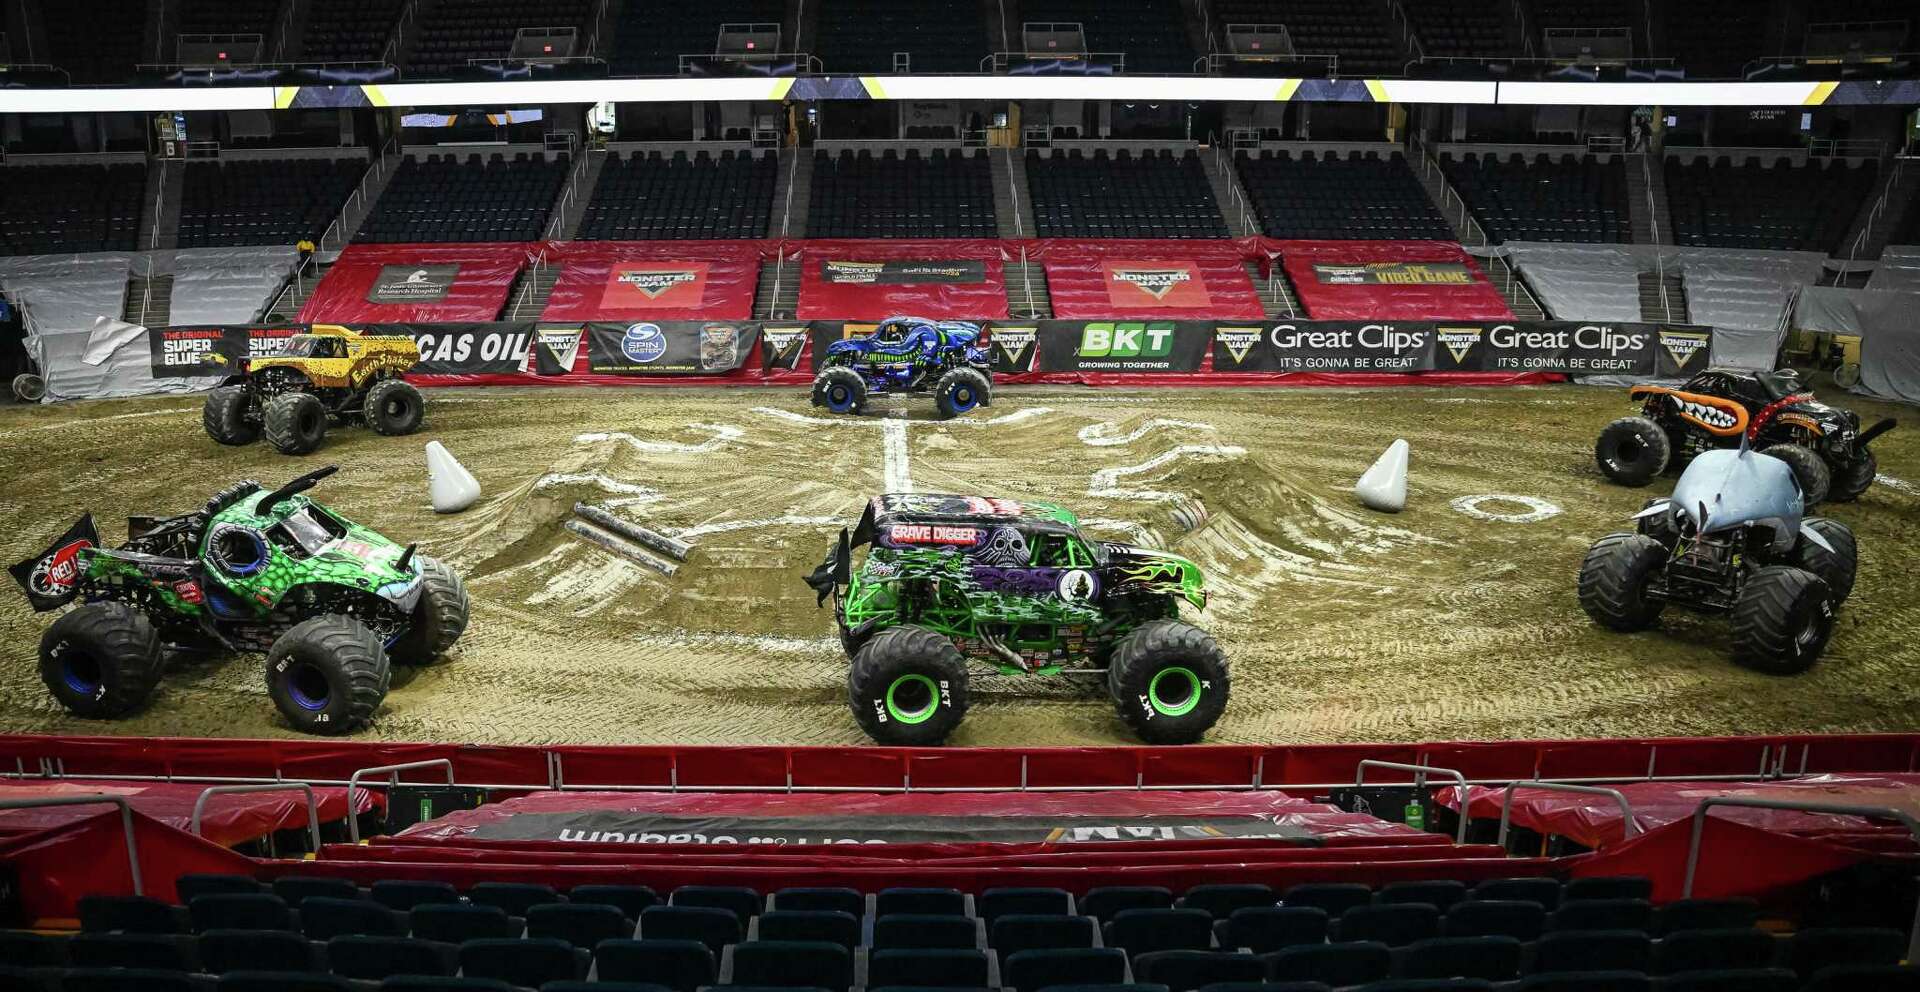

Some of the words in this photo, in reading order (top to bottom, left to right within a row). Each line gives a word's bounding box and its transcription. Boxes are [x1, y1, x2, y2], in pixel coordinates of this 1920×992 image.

[617, 274, 696, 282] MONSTER
[1423, 271, 1470, 282] GAME
[163, 332, 182, 340] THE
[183, 330, 223, 339] ORIGINAL
[249, 329, 265, 337] THE
[1216, 333, 1261, 342] MONSTER
[1437, 333, 1481, 342] MONSTER
[163, 339, 211, 351] SUPER
[249, 338, 291, 350] SUPE
[1003, 341, 1024, 349] JAM
[1083, 329, 1171, 350] BKT
[1229, 341, 1250, 349] JAM
[1271, 325, 1351, 348] Great
[1358, 325, 1424, 354] Clips
[1490, 325, 1569, 349] Great
[1574, 326, 1644, 356] Clips
[1660, 338, 1707, 347] MONSTER
[480, 333, 528, 361] OIL
[1670, 346, 1693, 354] JAM
[164, 352, 200, 366] GLUE
[1079, 361, 1120, 369] GROWING
[1122, 361, 1170, 369] TOGETHER
[1280, 357, 1301, 367] IT'S
[1306, 357, 1350, 367] GONNA
[1354, 358, 1370, 367] BE
[1375, 358, 1414, 367] GREAT
[1498, 357, 1519, 367] IT'S
[1523, 358, 1565, 367] GONNA
[1570, 358, 1586, 368] BE
[1591, 359, 1633, 369] GREAT
[352, 359, 380, 383] Earth
[380, 353, 413, 368] Shaker
[891, 525, 931, 539] GRAVE
[933, 526, 977, 541] DIGGER
[52, 560, 73, 581] RED
[940, 680, 951, 708] BKT
[873, 699, 887, 722] BKT
